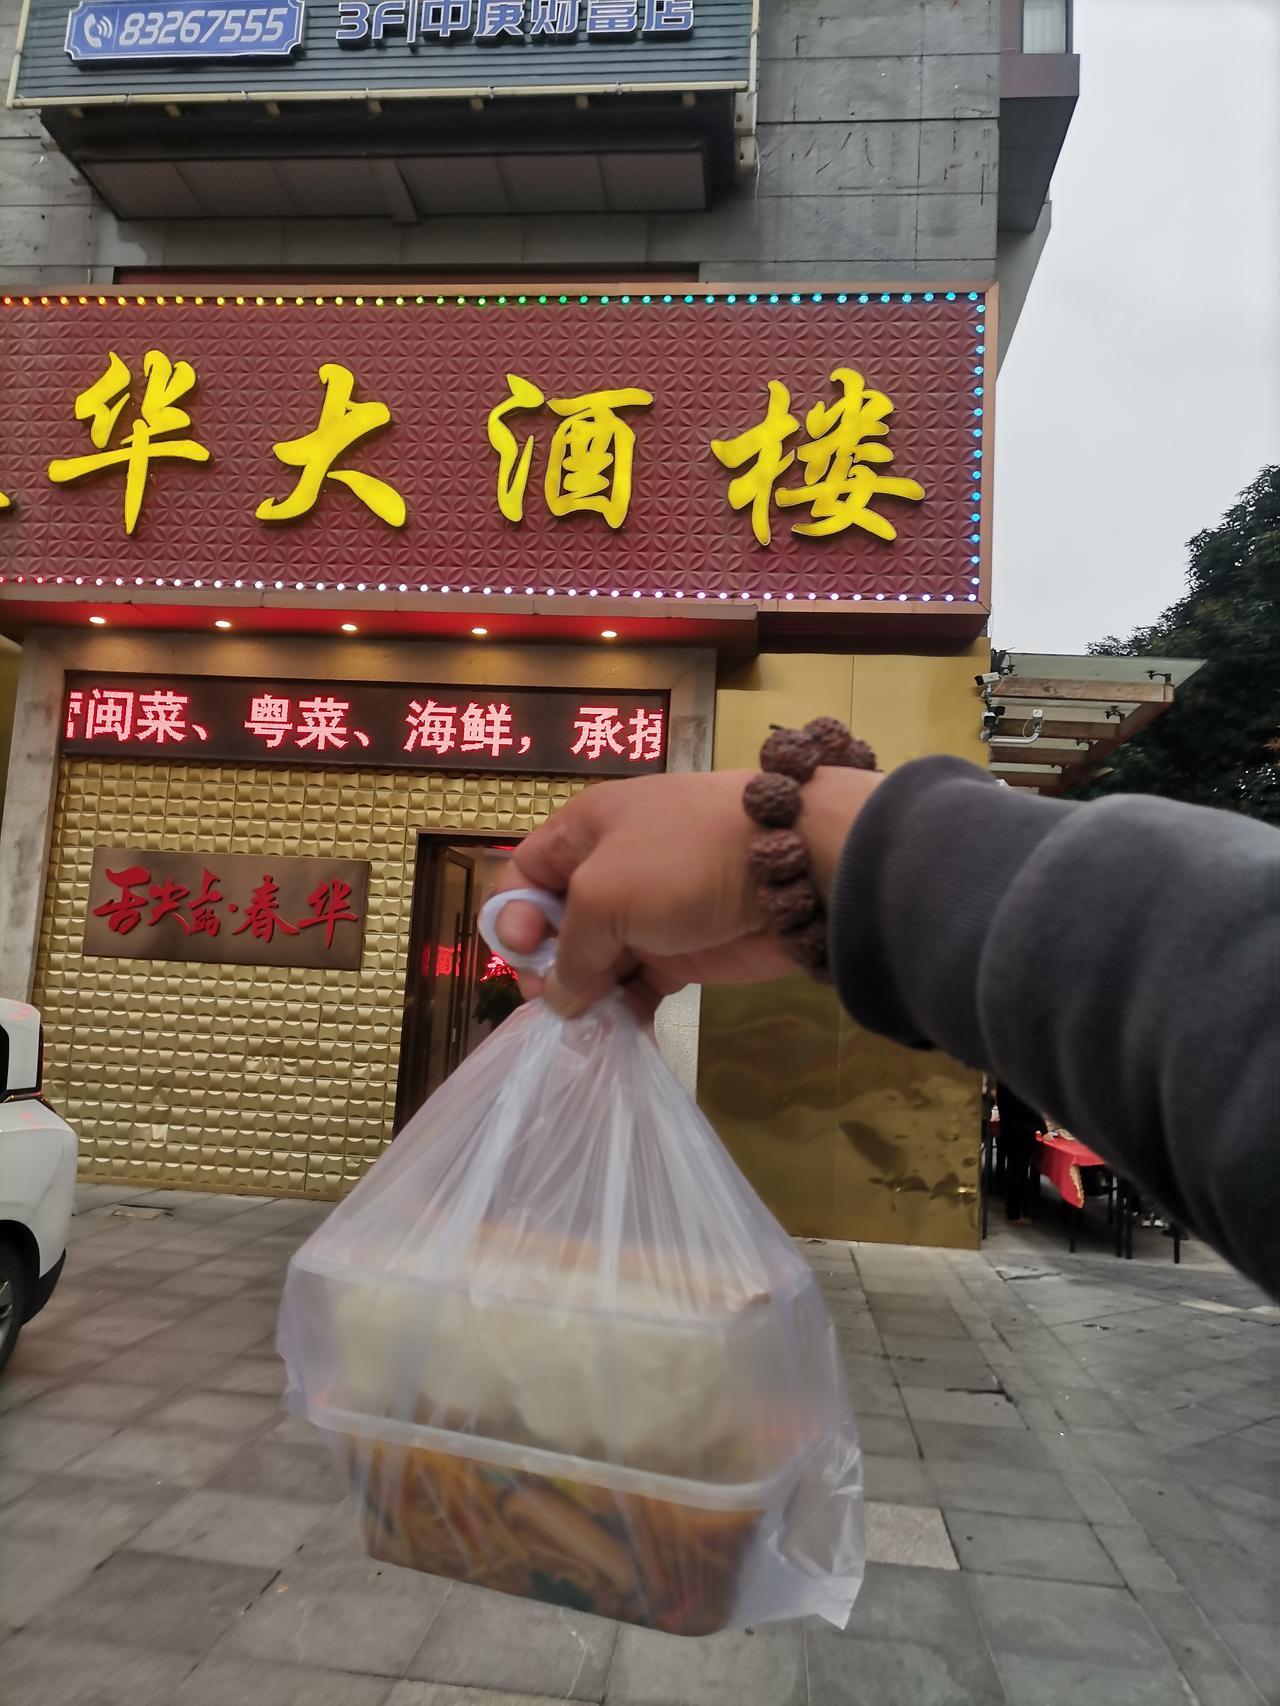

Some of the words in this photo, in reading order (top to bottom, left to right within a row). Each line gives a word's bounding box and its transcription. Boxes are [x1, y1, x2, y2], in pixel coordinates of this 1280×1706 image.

[118, 8, 288, 46] 83267555
[0, 349, 926, 546] 华大酒楼
